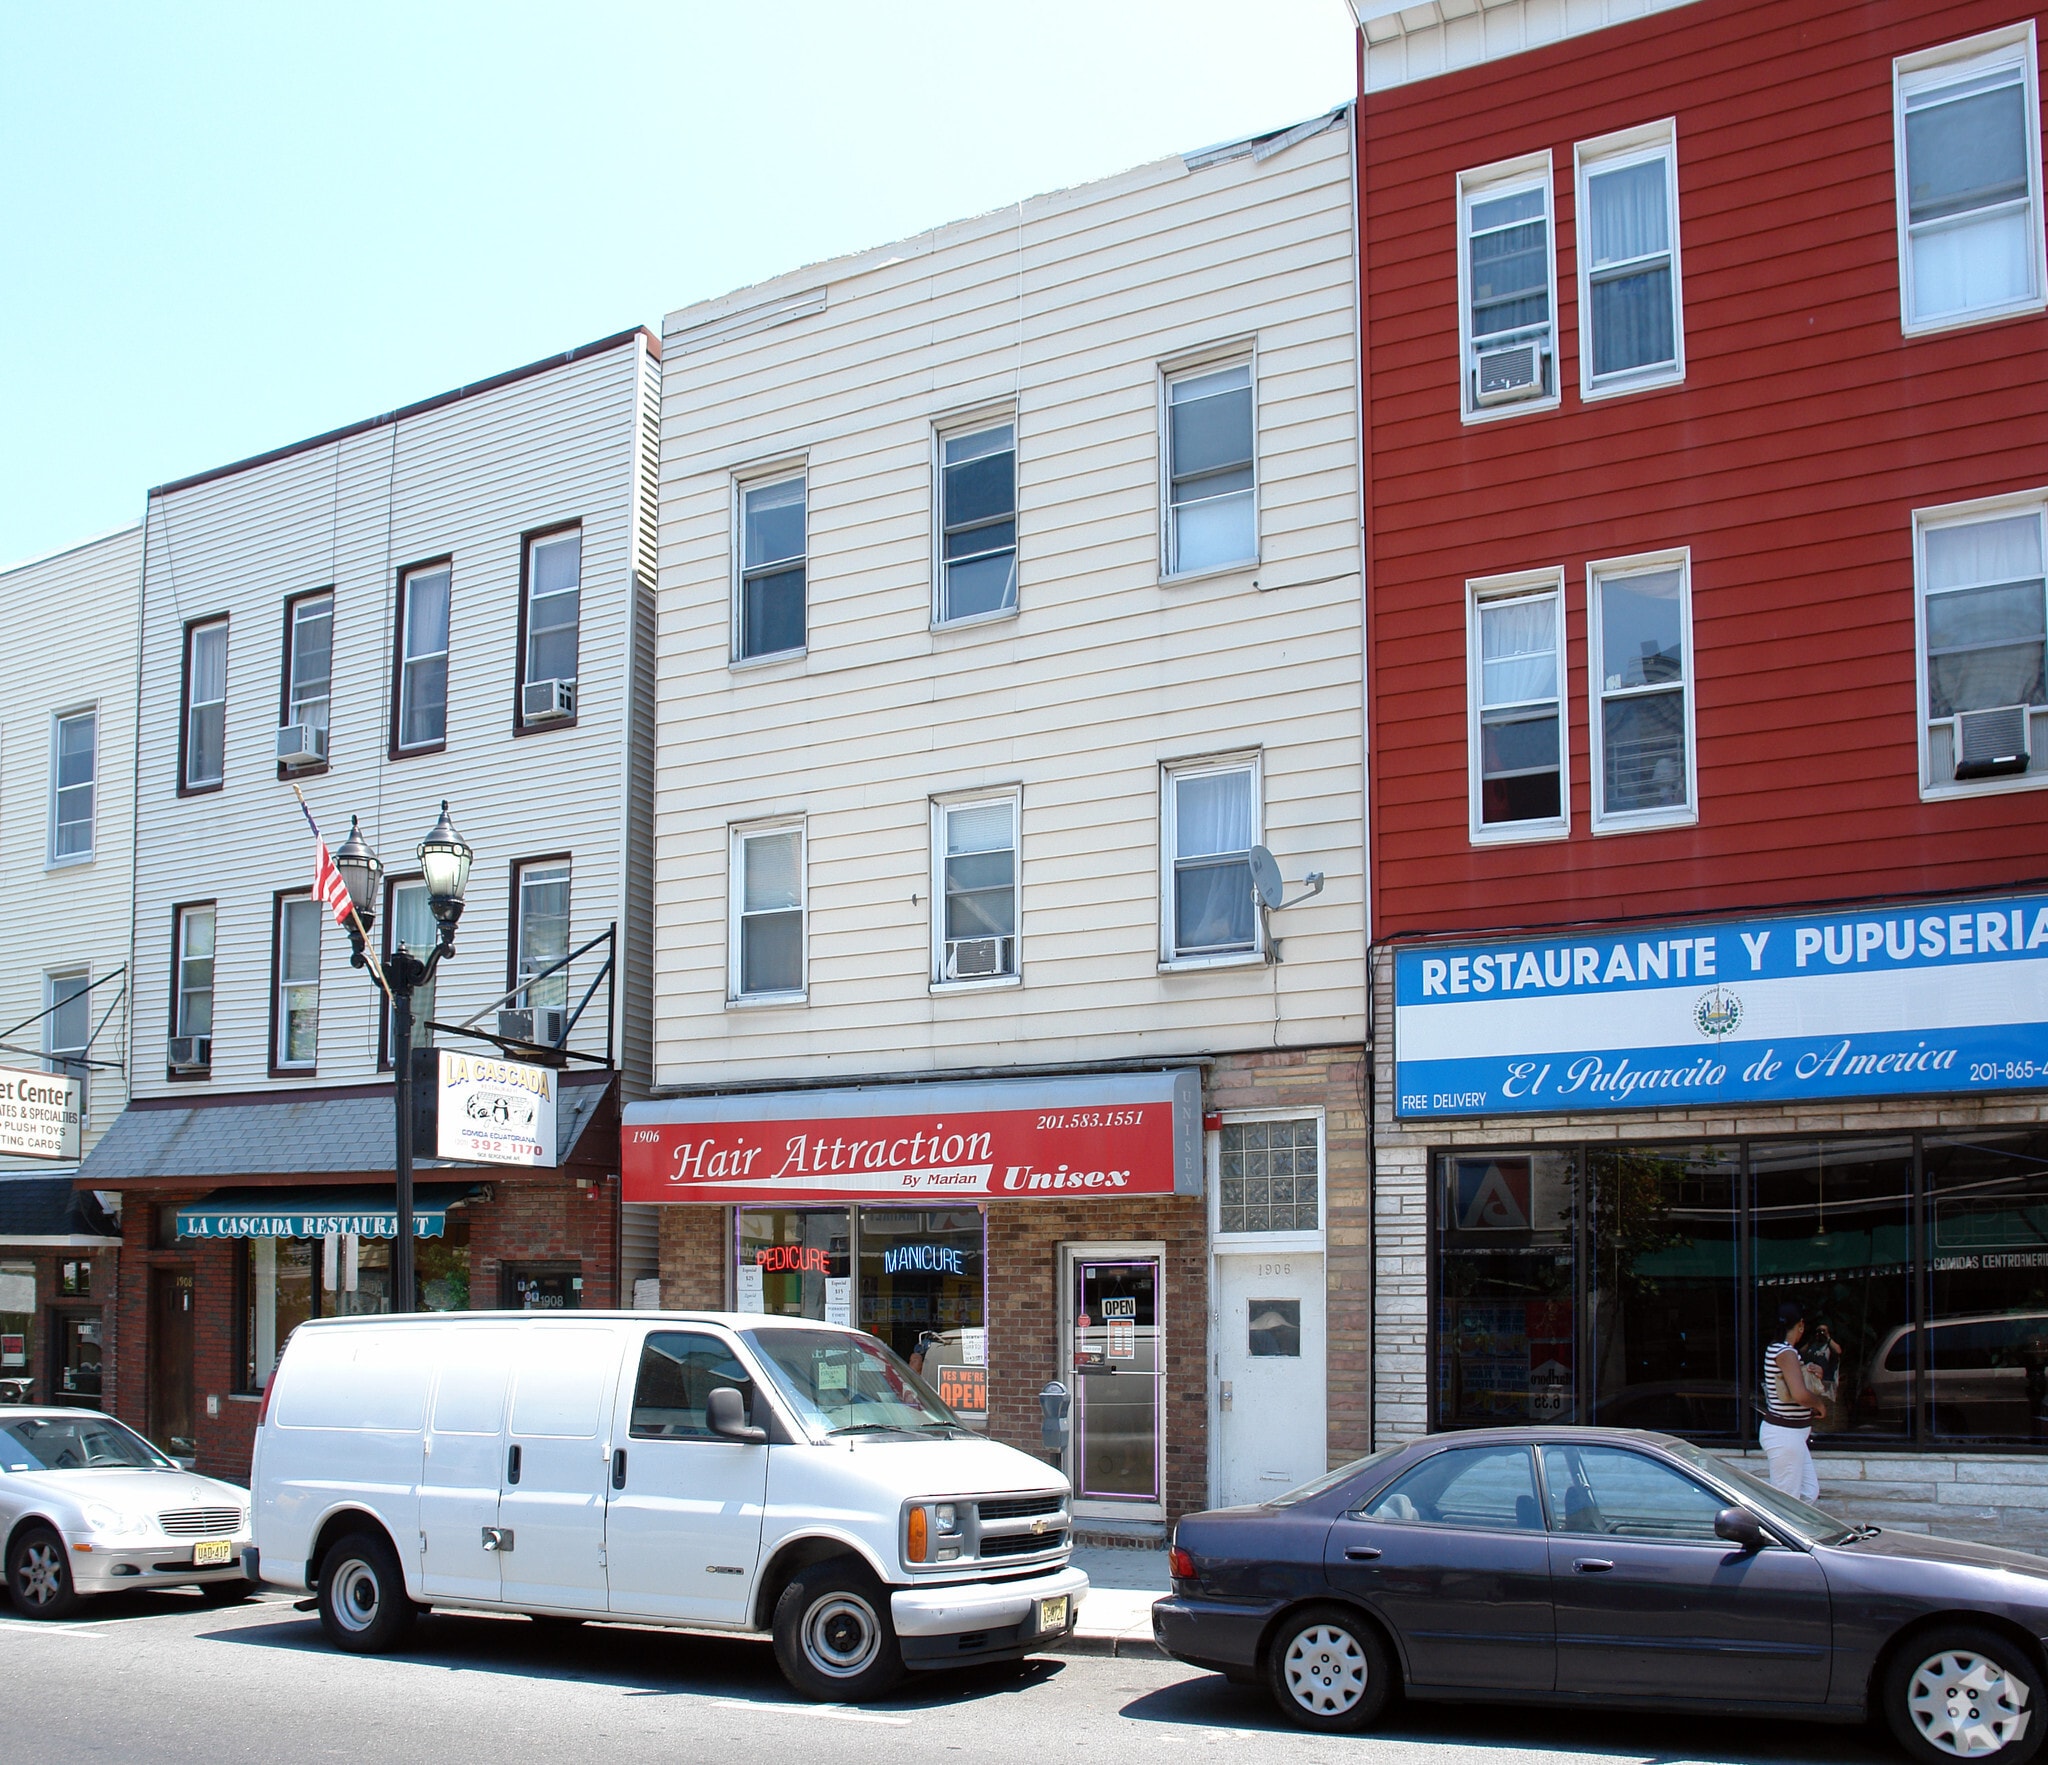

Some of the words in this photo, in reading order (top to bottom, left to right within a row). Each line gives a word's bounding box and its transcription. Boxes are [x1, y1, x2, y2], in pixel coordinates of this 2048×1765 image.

[1422, 937, 1716, 997] RESTAURANTE
[1740, 931, 1771, 971] Y
[1795, 907, 2048, 968] PUPUSERIA
[447, 1055, 470, 1088] LA
[473, 1060, 551, 1103] CASCADA
[1502, 1062, 1551, 1098] El
[1557, 1055, 1727, 1102] Pulgarcito
[1742, 1049, 1782, 1082] de
[1794, 1039, 1958, 1079] America
[17, 1079, 73, 1107] Center
[1402, 1095, 1428, 1111] FREE
[1433, 1091, 1487, 1109] DELIVERY
[21, 1106, 27, 1119] &
[29, 1107, 78, 1125] SPECIALTIES
[1036, 1110, 1144, 1130] 201.583.1551
[4, 1121, 37, 1133] PLUSH
[41, 1124, 66, 1137] TOYS
[461, 1128, 489, 1139] COMIDA
[632, 1129, 660, 1144] 1906
[1182, 1090, 1194, 1186] UNISEX
[28, 1137, 62, 1150] CARDS
[669, 1137, 762, 1181] Hair
[770, 1122, 994, 1180] Attraction
[902, 1174, 921, 1188] By
[926, 1173, 978, 1185] Marian
[1002, 1164, 1131, 1191] Unisex
[187, 1217, 209, 1234] LA
[217, 1217, 293, 1235] CASCADA
[302, 1216, 429, 1235] RESTAURAT
[756, 1246, 831, 1275] PEDICURE
[884, 1245, 968, 1275] MANICURE
[1258, 1263, 1292, 1277] 1906
[1933, 1256, 1980, 1271] COMIDAS
[1105, 1299, 1134, 1316] OPEN
[942, 1370, 957, 1381] YES
[960, 1370, 985, 1382] WE'RE
[940, 1381, 986, 1409] OPEN
